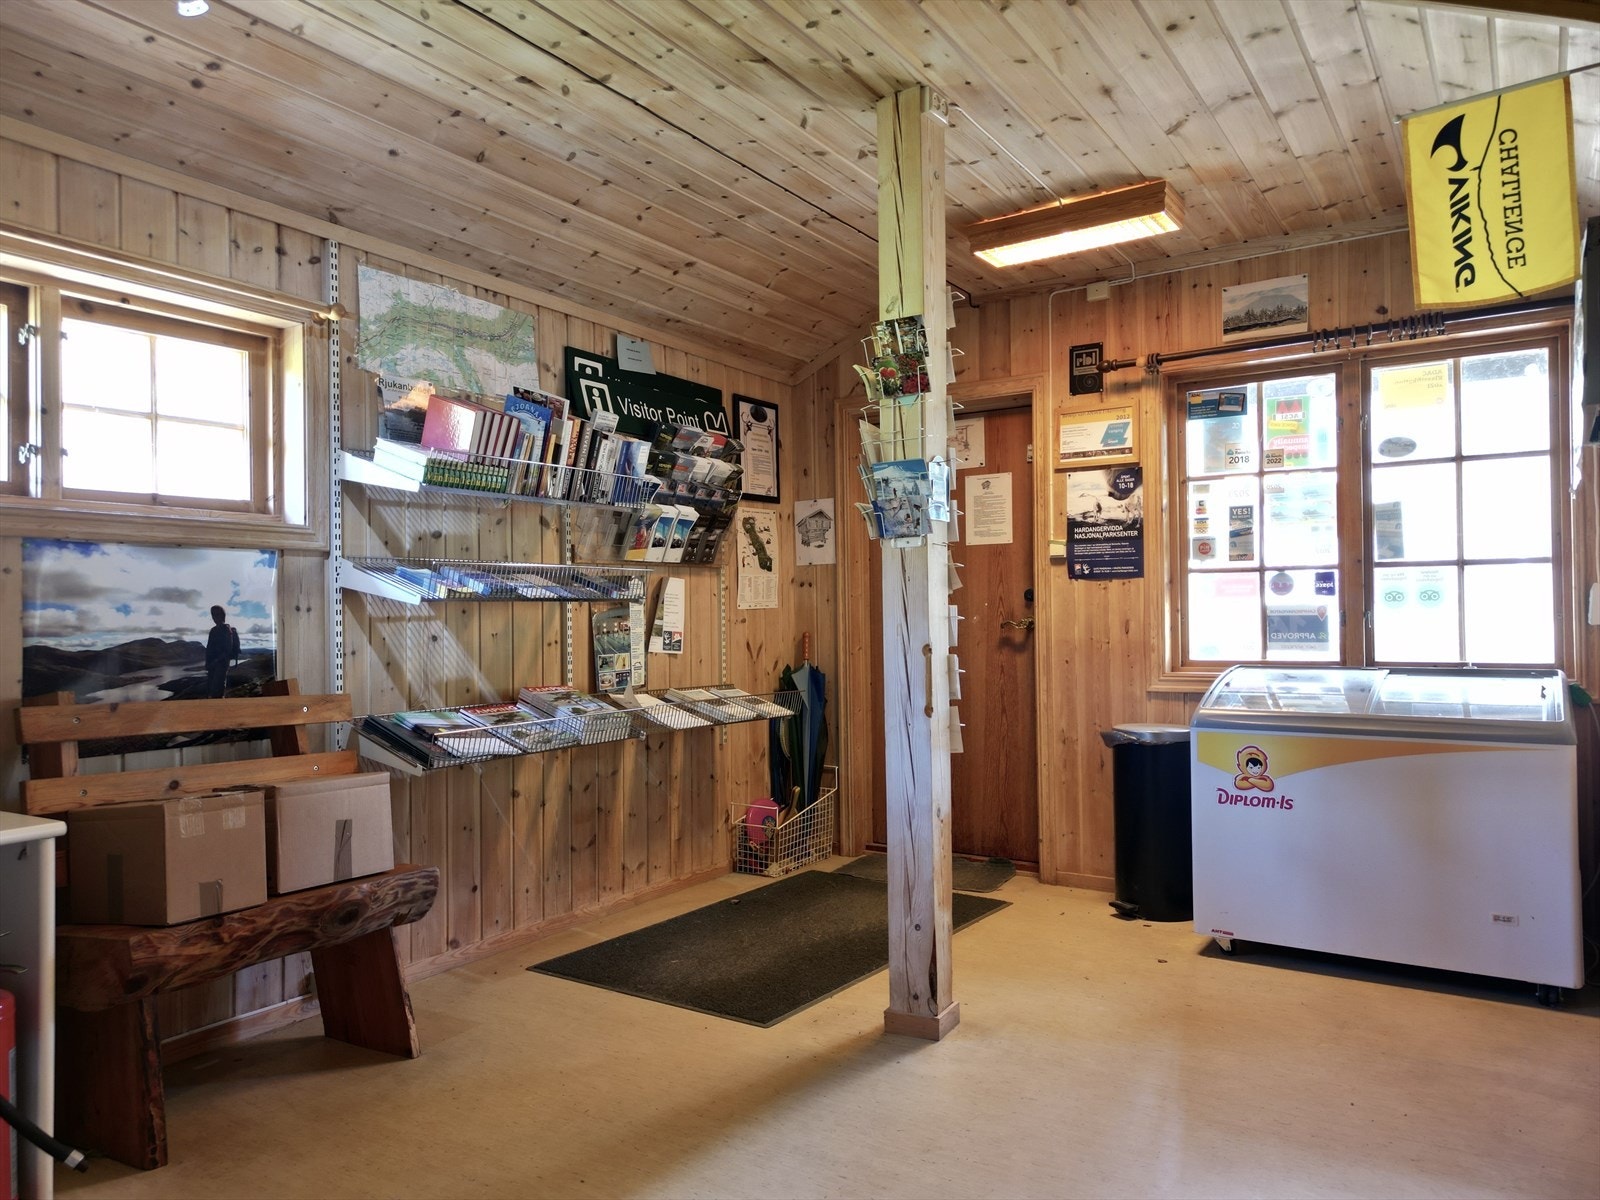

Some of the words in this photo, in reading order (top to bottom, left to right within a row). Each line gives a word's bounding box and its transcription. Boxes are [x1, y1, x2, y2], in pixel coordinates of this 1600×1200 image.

[616, 395, 663, 423] Visitor
[666, 406, 700, 429] Point
[1228, 455, 1250, 465] 2018
[1266, 457, 1282, 465] 2022
[1074, 525, 1123, 533] HARDANGERVIDDA
[1074, 531, 1139, 539] NASJONALPARKSENTER
